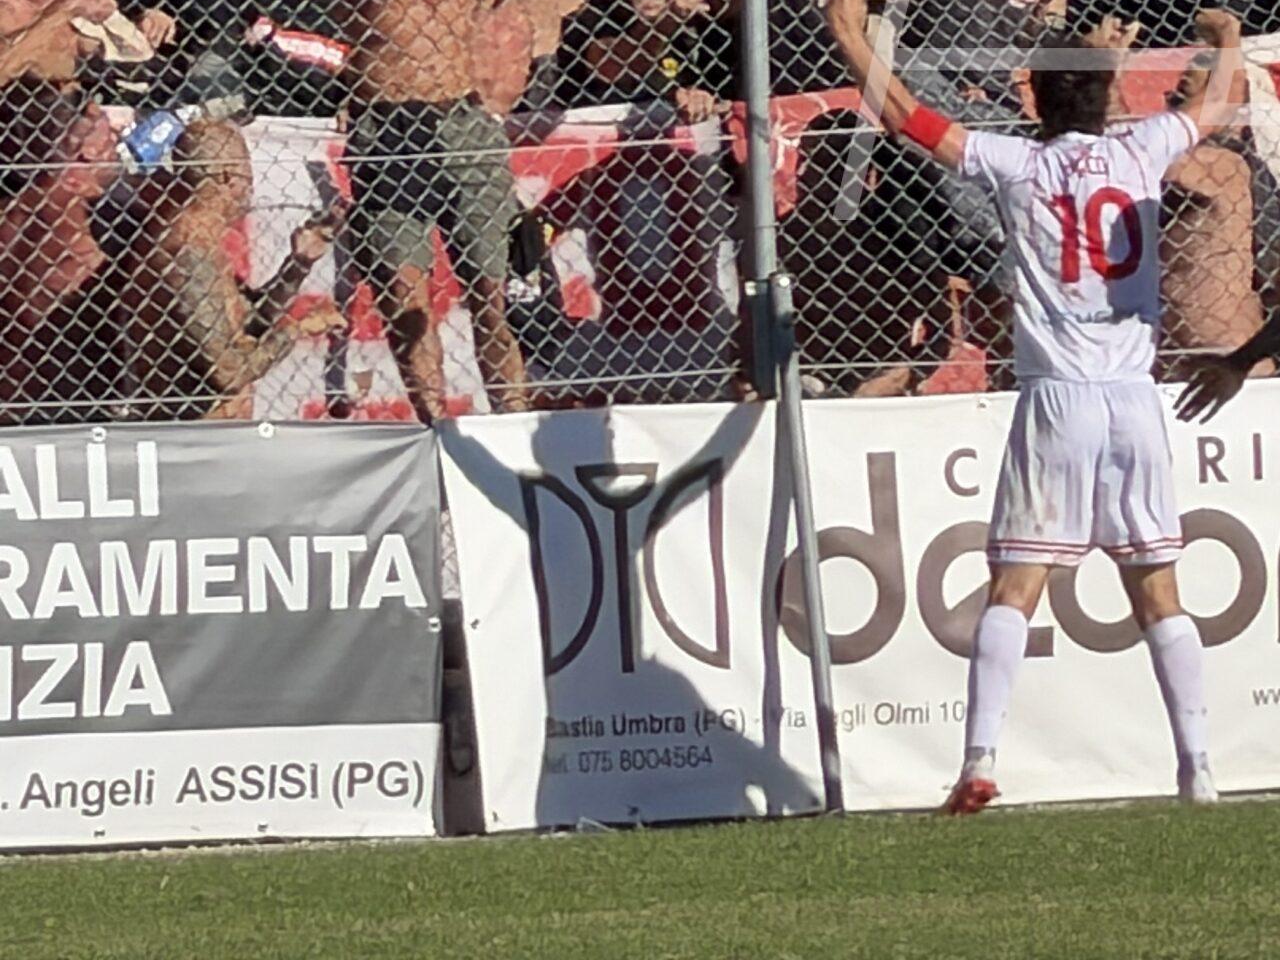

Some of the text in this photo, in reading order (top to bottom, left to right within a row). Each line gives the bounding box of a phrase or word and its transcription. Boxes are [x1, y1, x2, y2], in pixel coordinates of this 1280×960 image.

[1051, 186, 1144, 283] 10
[611, 713, 686, 736] Umbra
[695, 707, 746, 736] (PG)
[873, 700, 930, 726] Olmi
[578, 750, 613, 773] 075
[619, 744, 714, 773] 8004564
[20, 770, 154, 817] Angeli
[176, 763, 319, 804] ASSISI
[331, 760, 426, 809] (PG)
